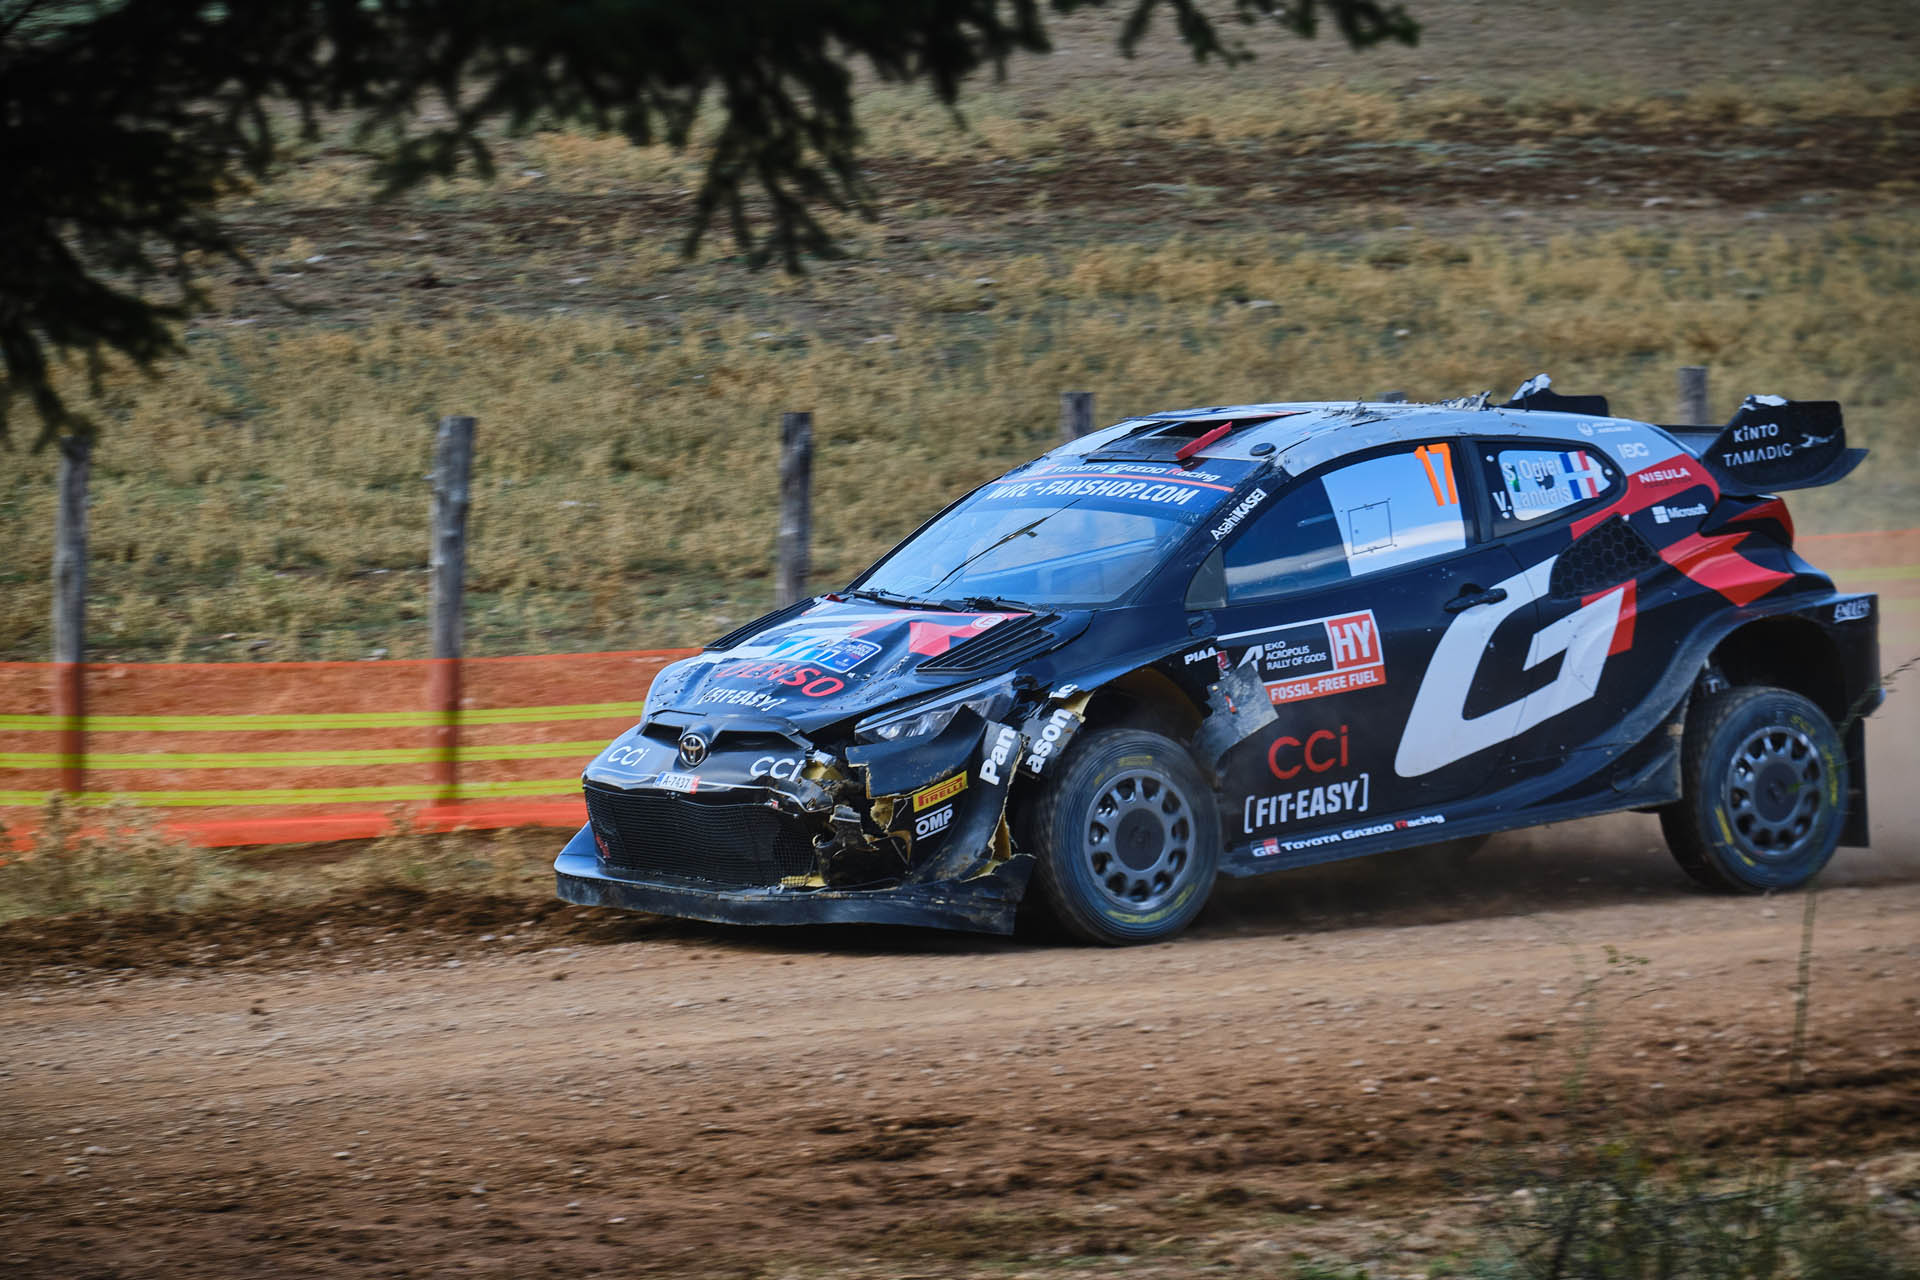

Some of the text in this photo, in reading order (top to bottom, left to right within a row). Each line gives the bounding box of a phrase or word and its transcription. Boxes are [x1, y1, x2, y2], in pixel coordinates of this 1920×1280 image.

[1722, 443, 1793, 467] TAMADIC
[1414, 442, 1458, 506] 17
[1638, 467, 1692, 483] NISULA
[987, 479, 1200, 505] WRC-FANSHOP.COM
[1265, 640, 1286, 652] EKO
[1266, 645, 1310, 661] ACROPOLIS
[1331, 619, 1371, 663] HY
[1184, 646, 1218, 665] PIAA
[1266, 652, 1327, 671] RALLY OF GODS
[715, 661, 845, 697] DENSO
[1271, 671, 1379, 702] FOSSIL-FREE FUEL
[979, 725, 1017, 786] Pan
[918, 775, 963, 807] PIRELLI
[915, 808, 954, 836] OMP
